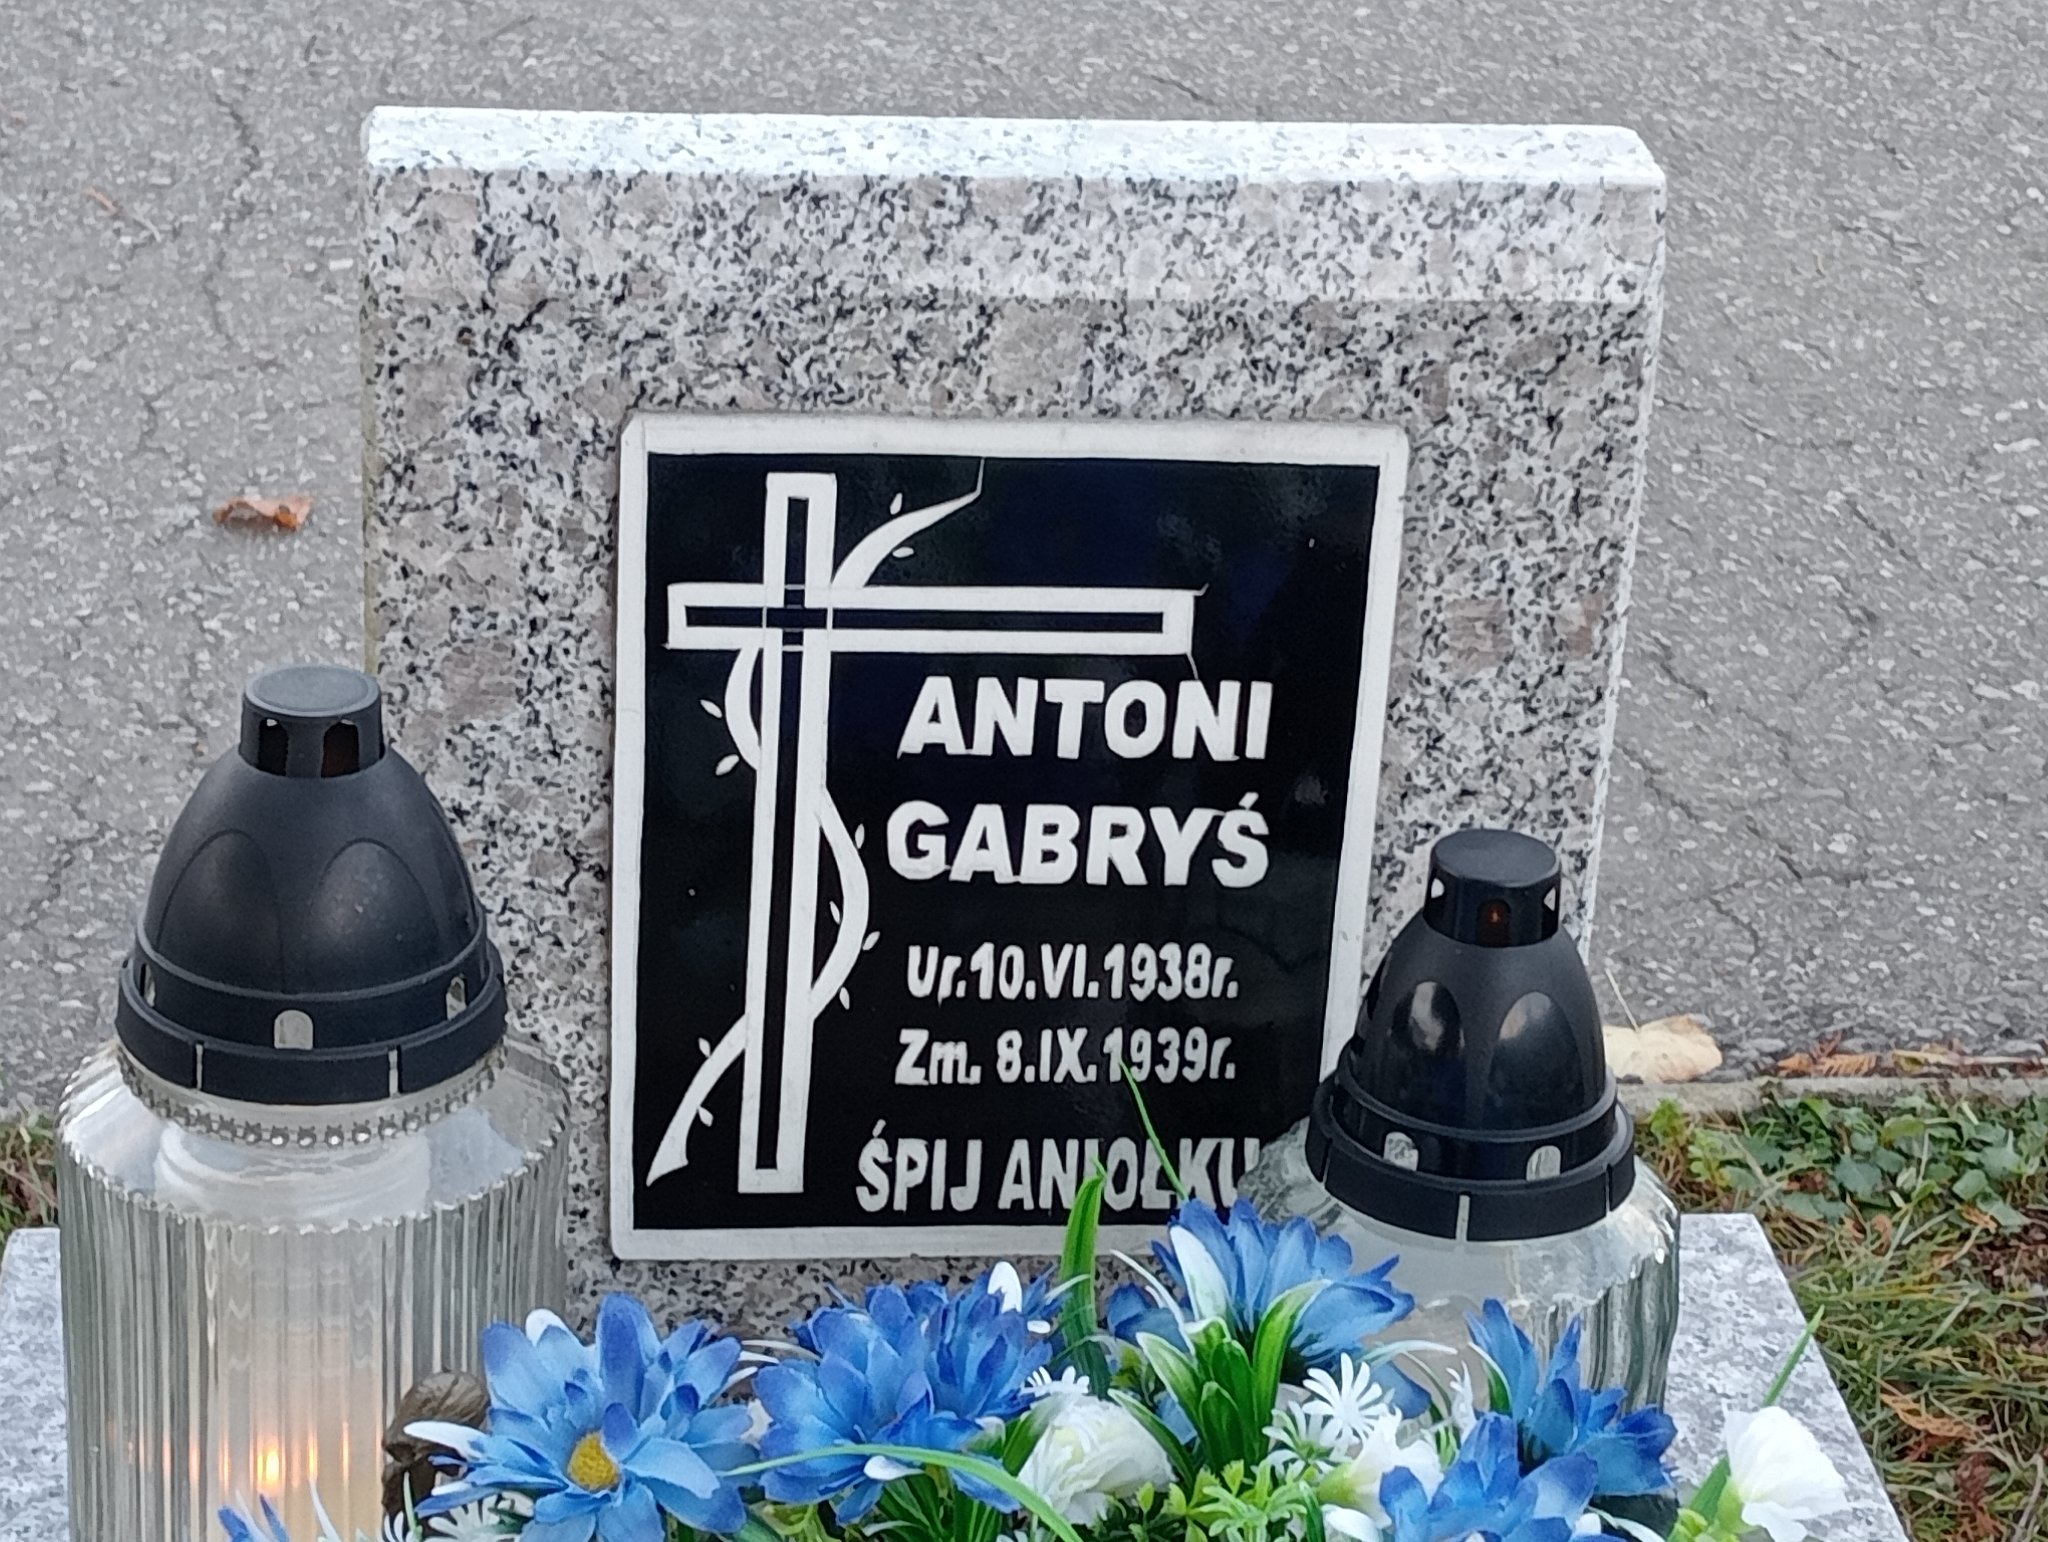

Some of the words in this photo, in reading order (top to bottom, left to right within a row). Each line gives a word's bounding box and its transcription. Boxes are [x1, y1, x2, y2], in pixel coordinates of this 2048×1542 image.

[897, 675, 1273, 761] ANTONI
[886, 792, 1270, 888] GABRYŚ
[895, 1028, 982, 1086] Zm.
[996, 1026, 1236, 1083] 8.IX.1939r.
[855, 1119, 983, 1212] ŚPIJ
